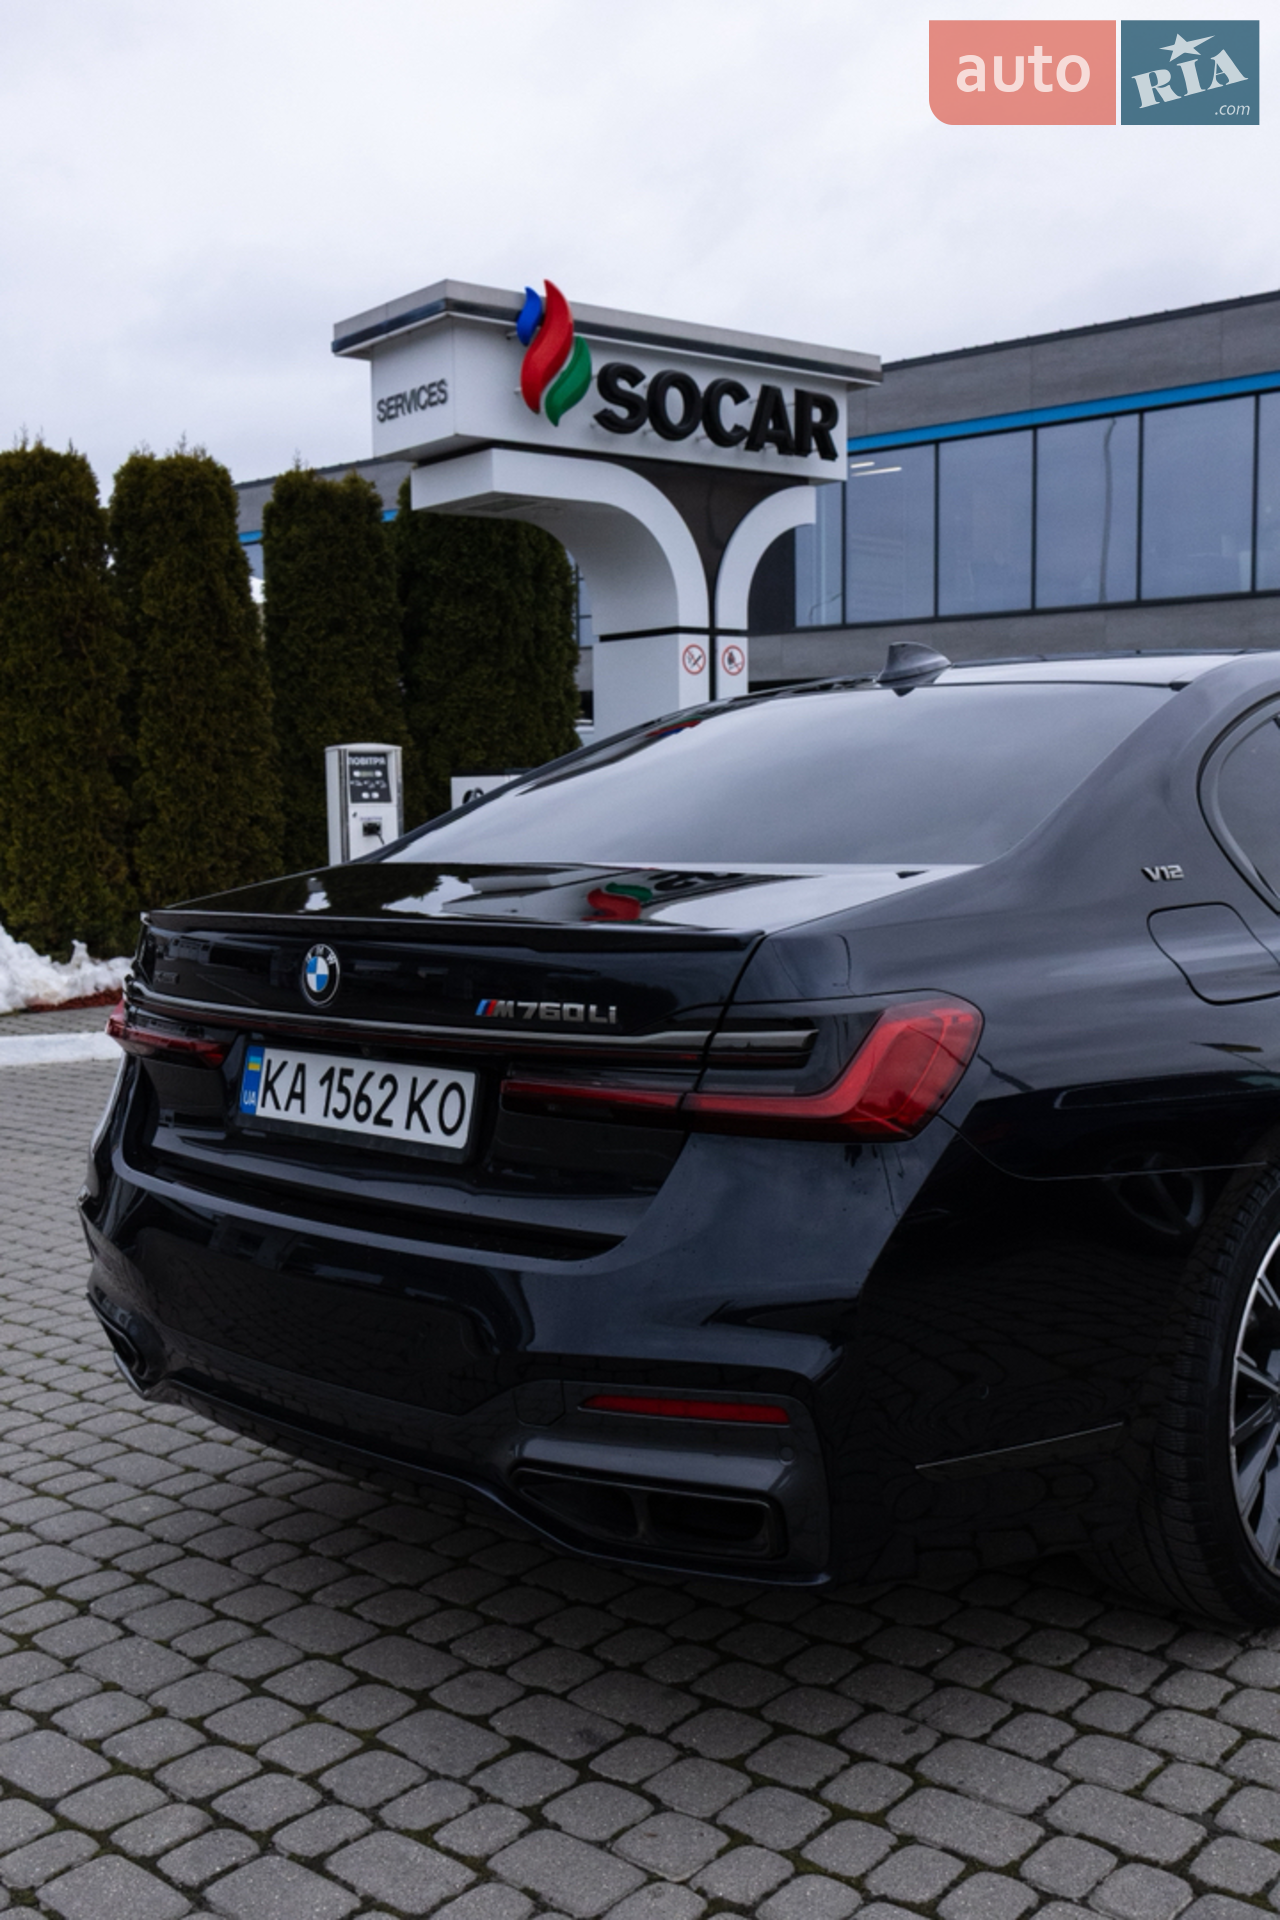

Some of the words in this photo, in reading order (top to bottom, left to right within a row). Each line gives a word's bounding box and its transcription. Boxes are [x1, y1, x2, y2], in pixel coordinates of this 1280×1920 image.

[376, 379, 448, 423] SERVICES
[593, 361, 839, 461] SOCAR
[1143, 864, 1184, 881] V12
[243, 1089, 256, 1106] UA
[260, 1058, 306, 1114] KA
[319, 1066, 398, 1128] 1562
[404, 1076, 467, 1137] KO
